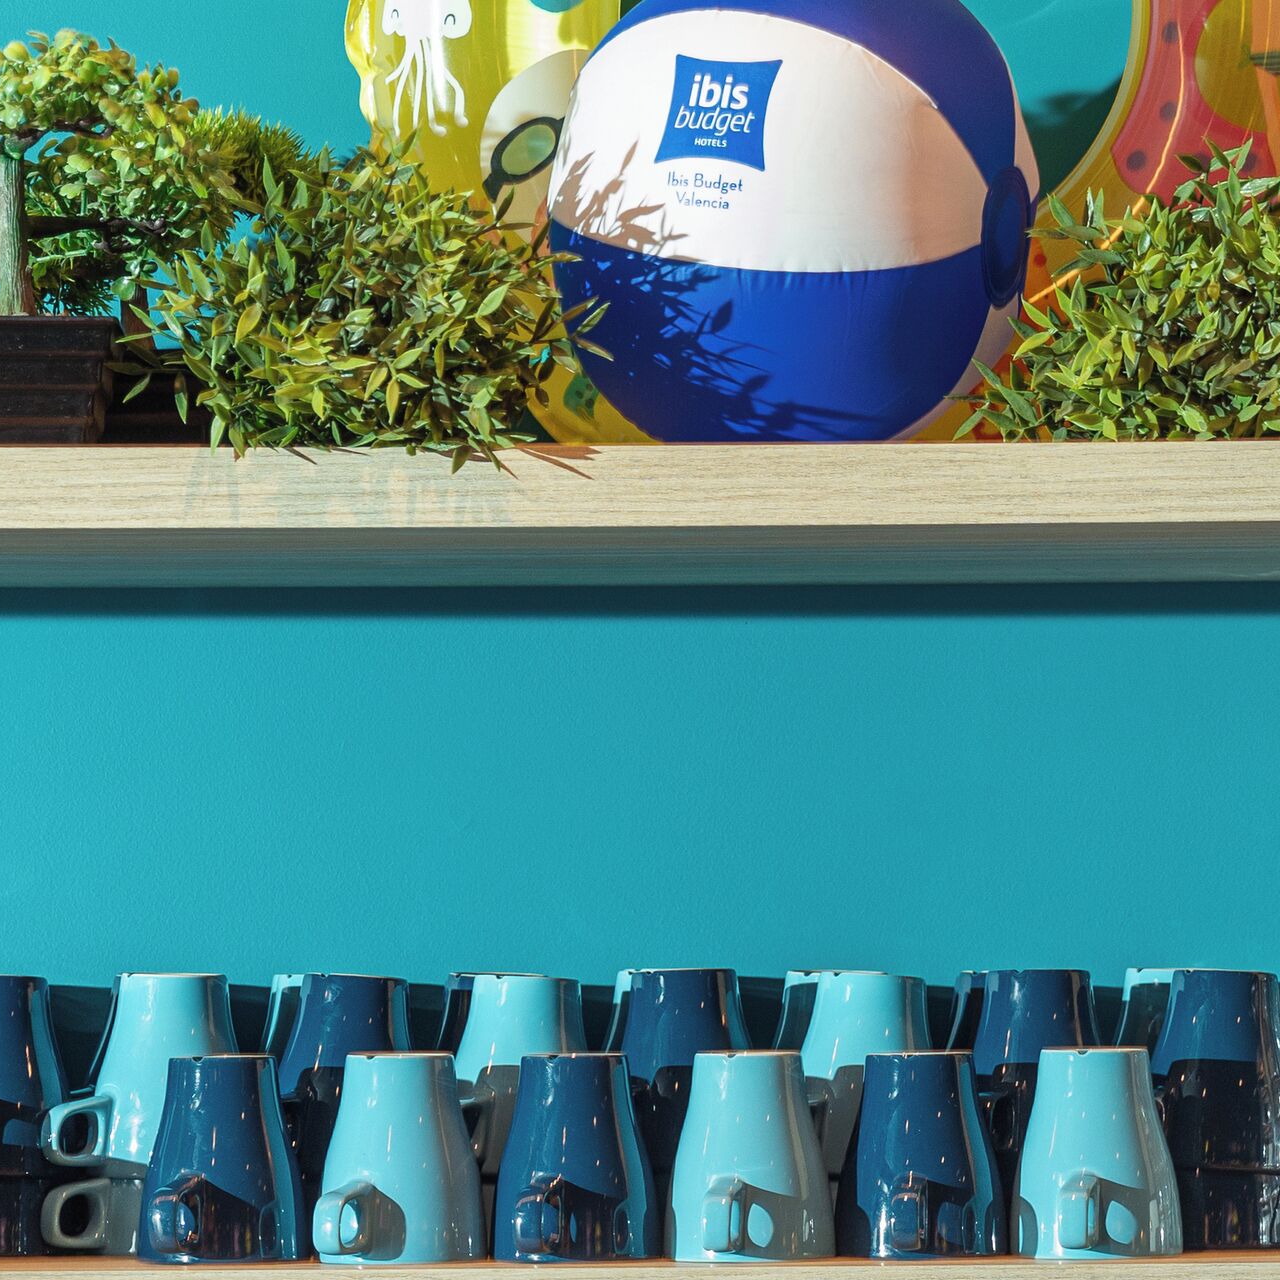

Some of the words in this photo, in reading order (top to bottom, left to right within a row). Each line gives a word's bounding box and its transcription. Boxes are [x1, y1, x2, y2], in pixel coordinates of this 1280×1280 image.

[689, 72, 750, 110] ibis
[674, 106, 756, 136] budget
[694, 138, 728, 148] HOTELS
[667, 171, 688, 187] Ibis
[694, 173, 743, 194] Budget
[676, 191, 730, 210] Valencia
